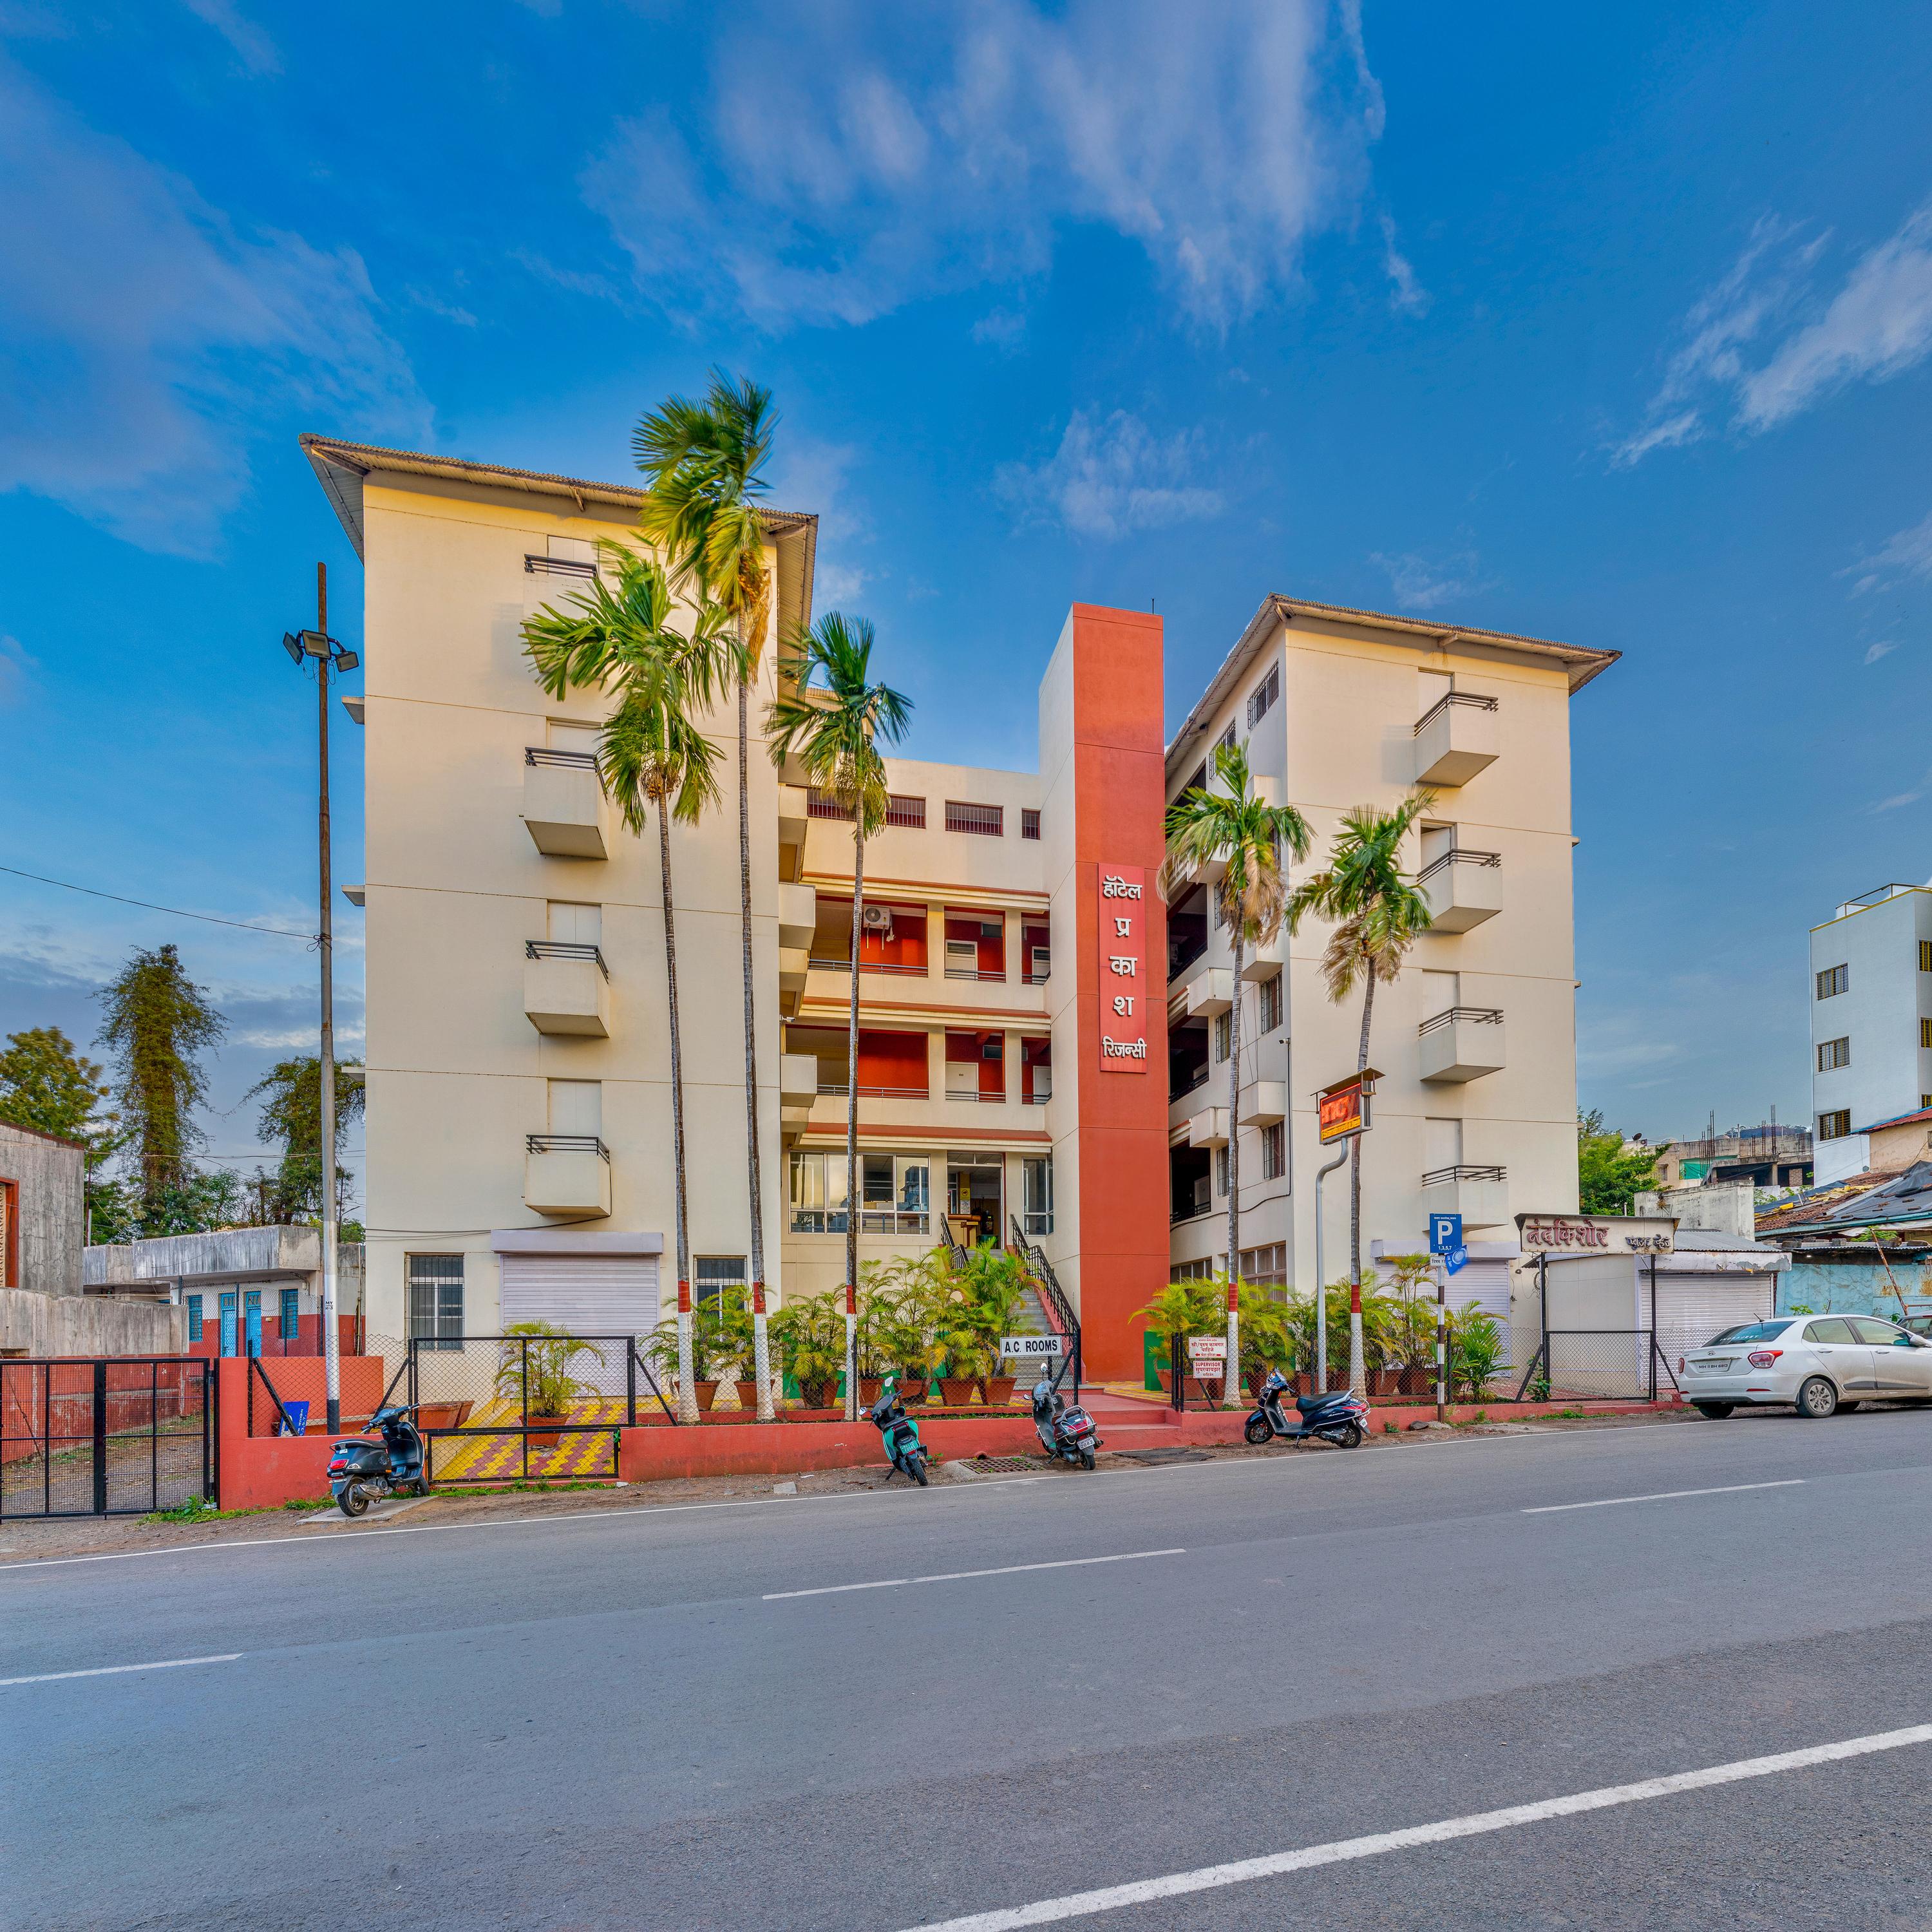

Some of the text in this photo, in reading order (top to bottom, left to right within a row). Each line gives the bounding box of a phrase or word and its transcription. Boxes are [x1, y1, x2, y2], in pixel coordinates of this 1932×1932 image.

[1103, 875, 1142, 900] हॉटेल
[1103, 1036, 1147, 1059] रिजन्सी
[1438, 1221, 1453, 1245] P
[1526, 1218, 1610, 1247] नंदकिशोर
[1005, 1340, 1058, 1353] A.C. ROOMS
[1080, 1440, 1094, 1448] 2082
